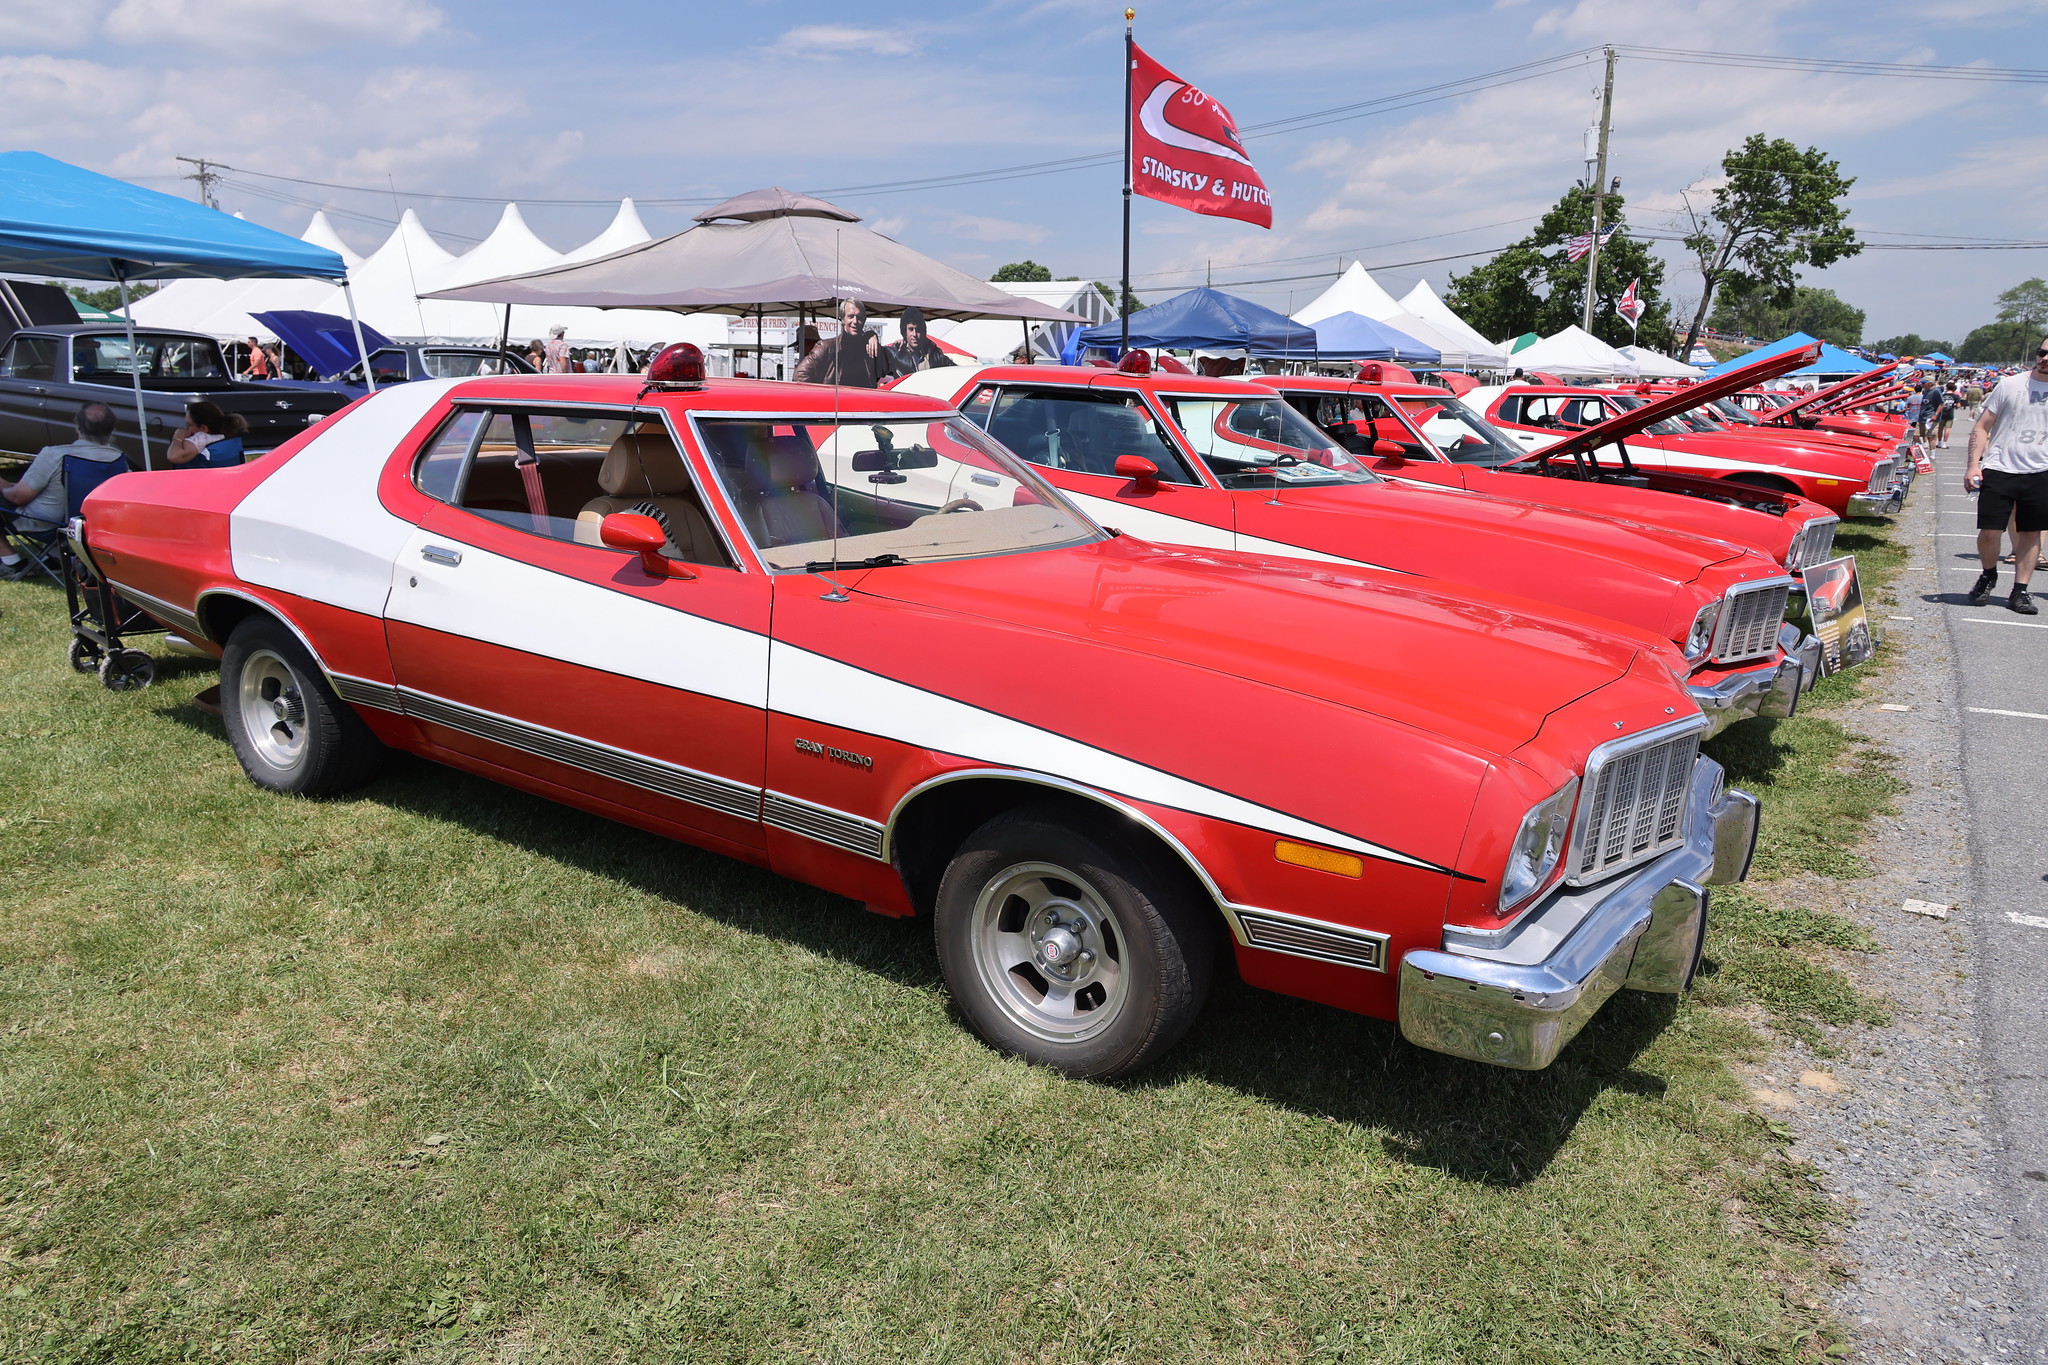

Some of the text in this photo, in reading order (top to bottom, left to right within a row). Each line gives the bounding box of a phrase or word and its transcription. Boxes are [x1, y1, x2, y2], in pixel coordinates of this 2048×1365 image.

[1141, 155, 1272, 206] STARSKY & HUTCH
[768, 318, 787, 328] FRIES
[794, 738, 873, 767] GRAN TORINO
